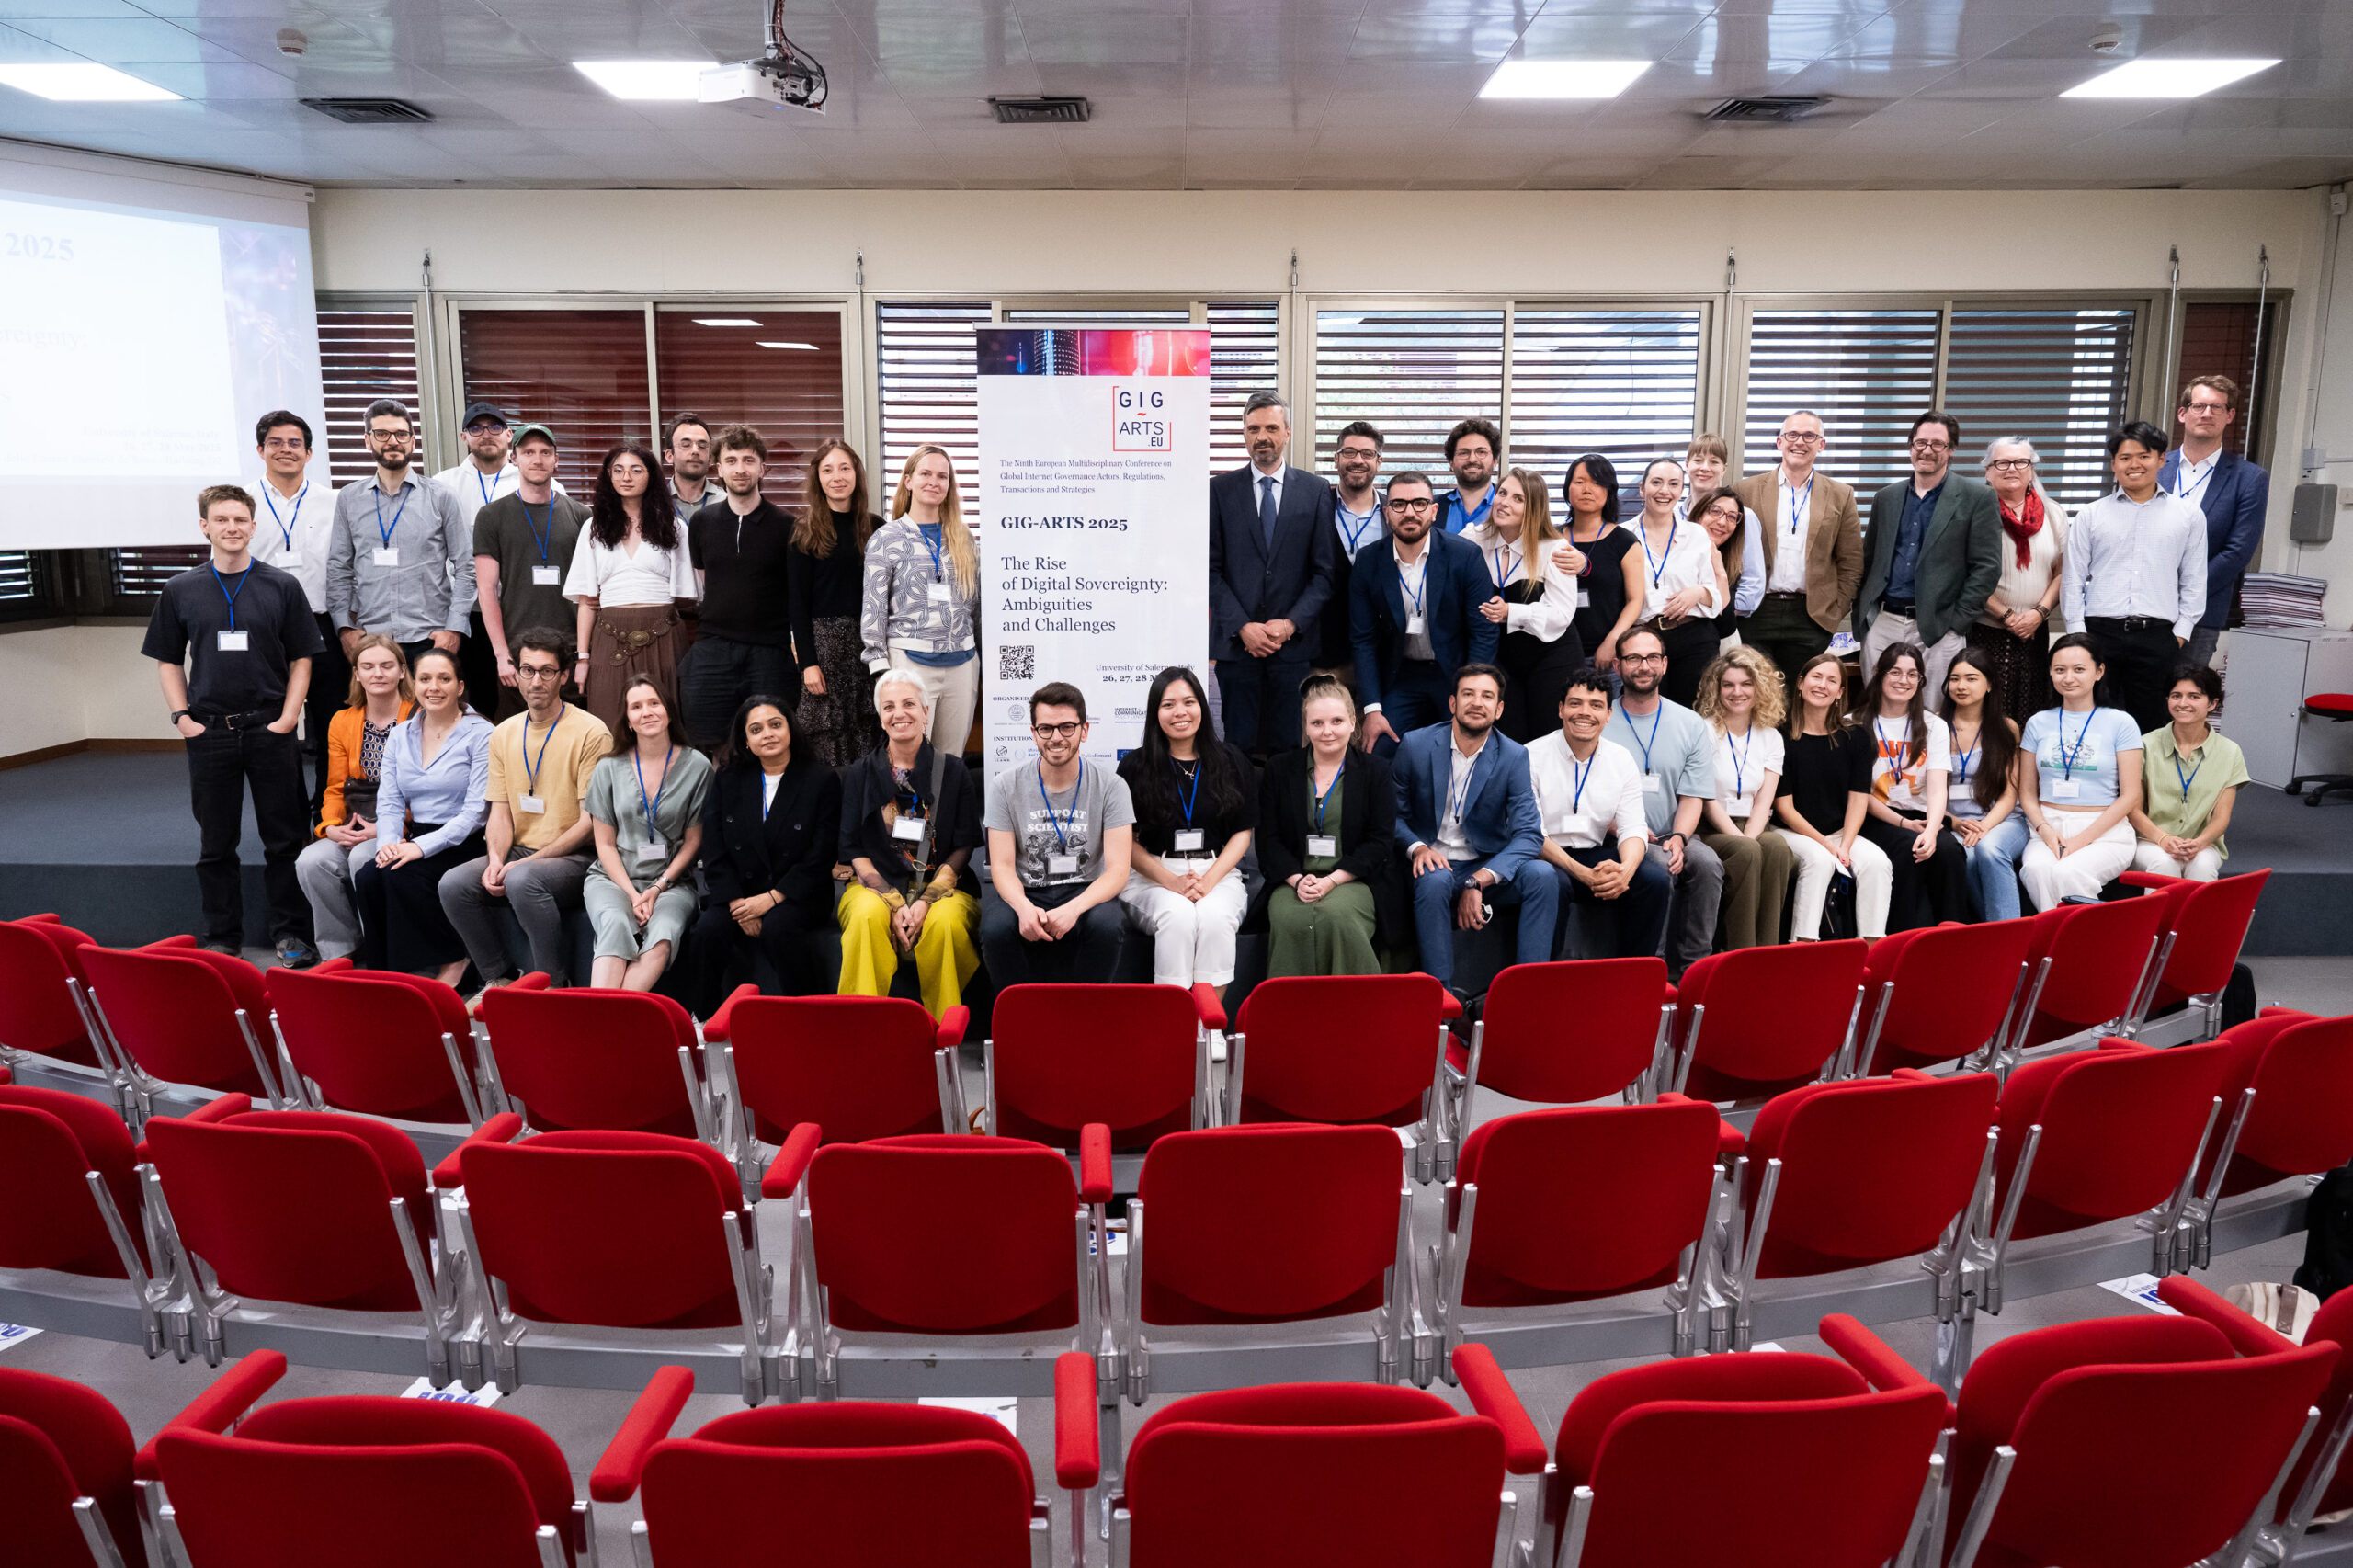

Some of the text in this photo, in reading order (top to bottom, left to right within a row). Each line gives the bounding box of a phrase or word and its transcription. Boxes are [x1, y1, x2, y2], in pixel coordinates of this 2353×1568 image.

[5, 232, 74, 262] 2025
[1119, 392, 1164, 408] GIG
[1119, 422, 1164, 436] ARTS
[1034, 460, 1066, 469] European
[1068, 460, 1123, 469] Multidisciplinary
[1125, 460, 1162, 468] Conference
[1000, 472, 1165, 482] Global Internet Governance Actors, Regulations,
[1000, 485, 1096, 494] Transactions and Strategies
[1001, 517, 1128, 531] GIG-ARTS 2025
[1001, 556, 1067, 570] The Rise
[1002, 576, 1167, 594] of Digital Sovereignty:
[1002, 597, 1092, 614] Ambiguities
[1002, 618, 1116, 634] and Challenges
